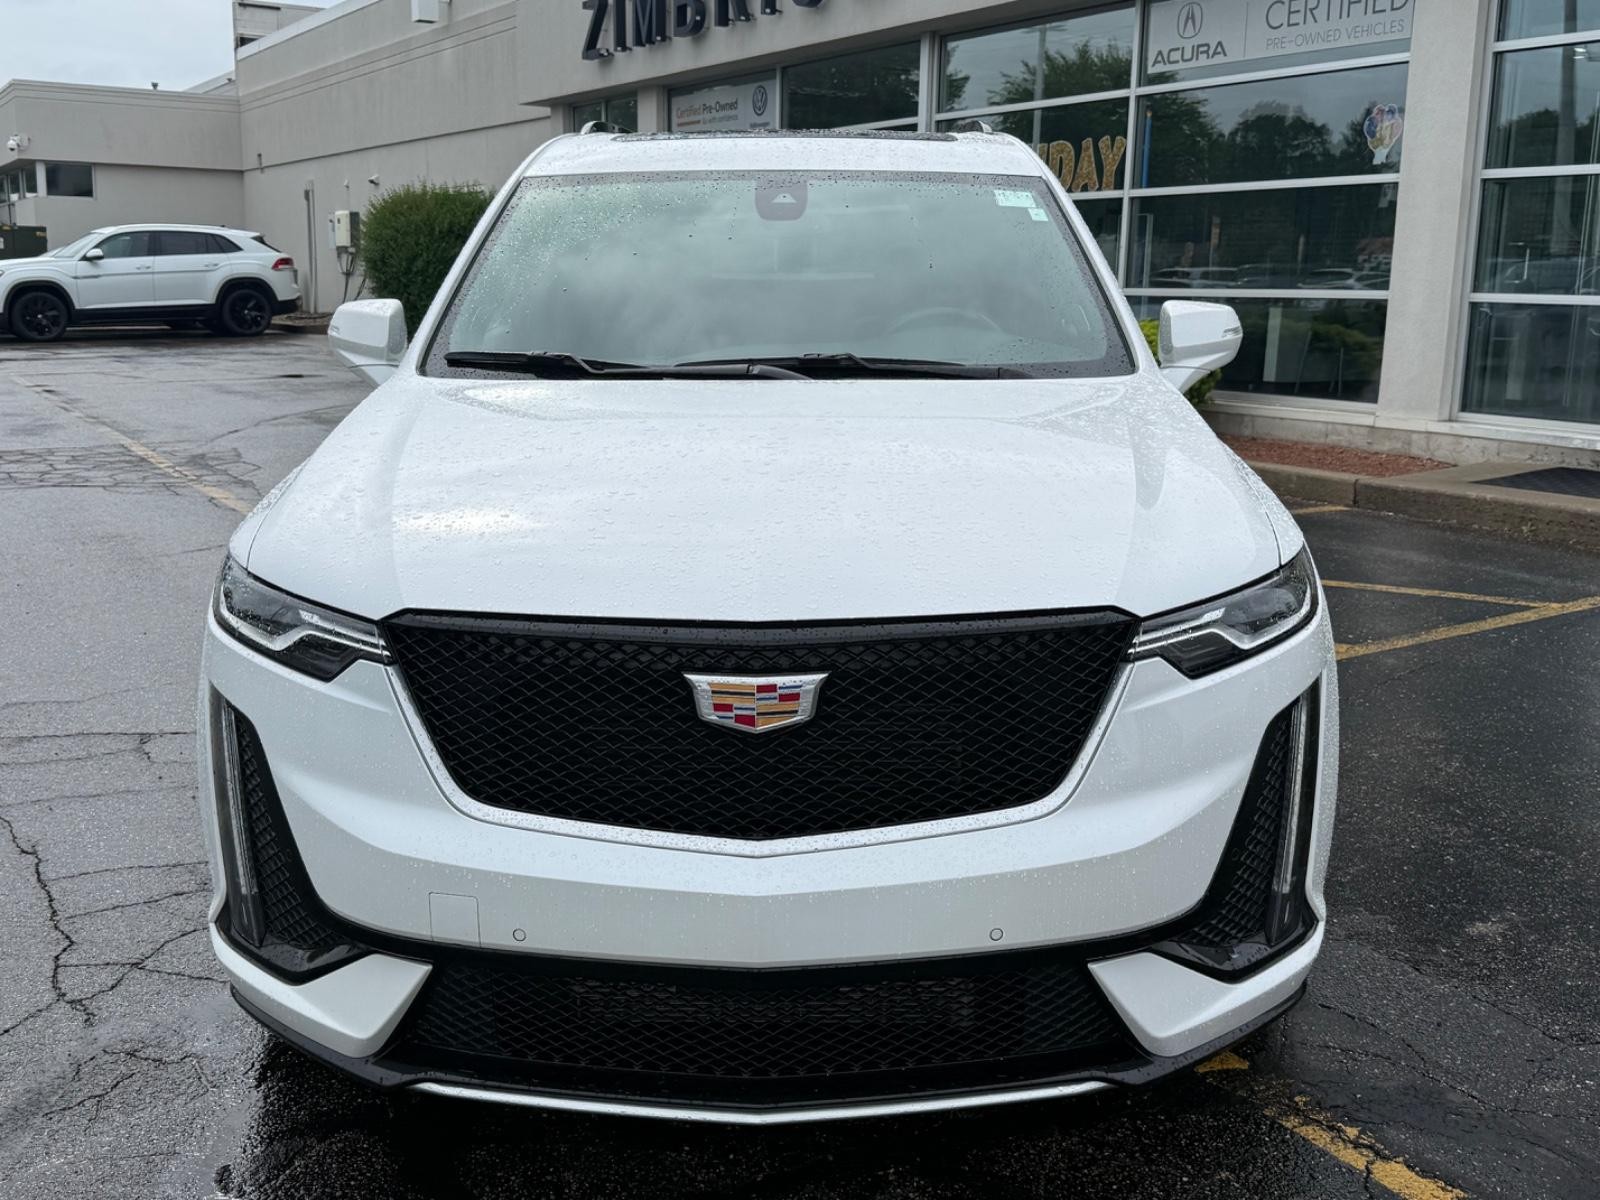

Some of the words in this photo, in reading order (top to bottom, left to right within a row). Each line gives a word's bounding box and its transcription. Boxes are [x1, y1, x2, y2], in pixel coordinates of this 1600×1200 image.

[581, 0, 826, 60] ZIMB
[1266, 28, 1342, 50] PRE-OWNED
[1345, 19, 1405, 39] VEHICLES
[1151, 41, 1227, 67] ACURA
[702, 97, 738, 114] Pre-Owned
[1037, 135, 1127, 192] DAY
